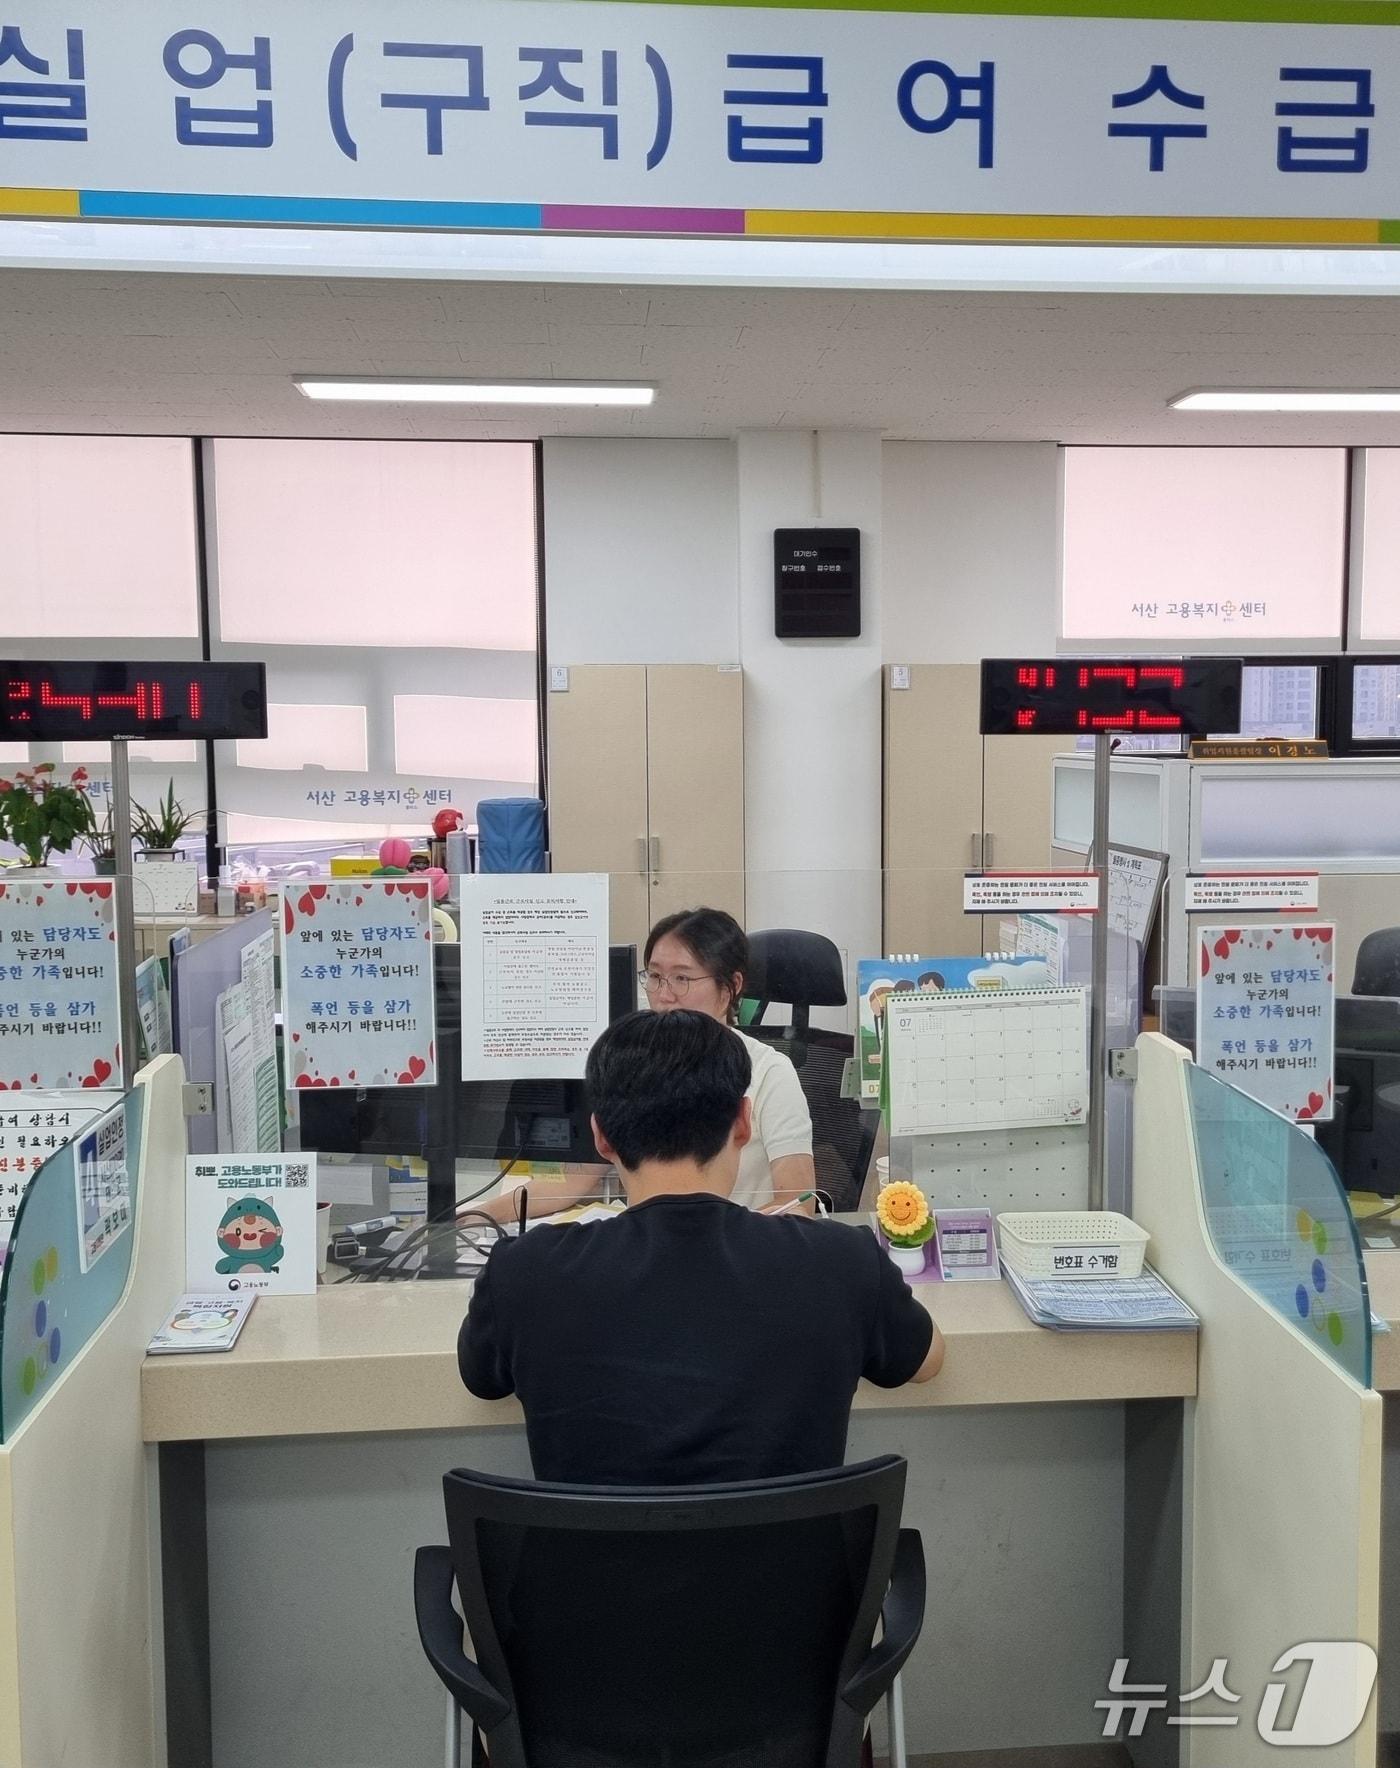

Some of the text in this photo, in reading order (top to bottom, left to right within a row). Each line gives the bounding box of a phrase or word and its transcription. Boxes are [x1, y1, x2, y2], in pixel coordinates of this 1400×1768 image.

[1107, 64, 1375, 173] 수급
[1131, 603, 1159, 617] 서산
[1239, 602, 1266, 618] 센터
[306, 790, 336, 806] 서산
[422, 789, 452, 806] 센터
[11, 927, 102, 942] 있는 담당자도
[300, 926, 417, 943] 앞에 있는 담당자도
[16, 947, 65, 961] 누군가의
[336, 947, 383, 960] 누군가의
[32, 964, 104, 980] 가족입니다!
[300, 964, 420, 979] 소중한 가족입니다!
[1214, 968, 1321, 985] 앞에 있는 담당자도
[1246, 988, 1288, 1001] 누군가의
[29, 1002, 57, 1017] 등을
[67, 1001, 96, 1016] 삼가
[311, 1000, 411, 1016] 폭언 등을 삼가
[1213, 1003, 1321, 1019] 소중한 가족입니다!
[42, 1021, 102, 1035] 바랍니다!!
[305, 1019, 417, 1033] 해주시기 바랍니다!!
[899, 1018, 912, 1028] 07
[1221, 1038, 1312, 1053] 폭언 등을 삼가
[1216, 1056, 1317, 1071] 해주시기 바랍니다!!
[0, 1114, 18, 1127] 여
[221, 1164, 282, 1176] 고용노동부가
[217, 1177, 282, 1189] 도와드립니다!
[1054, 1254, 1084, 1270] 번호표
